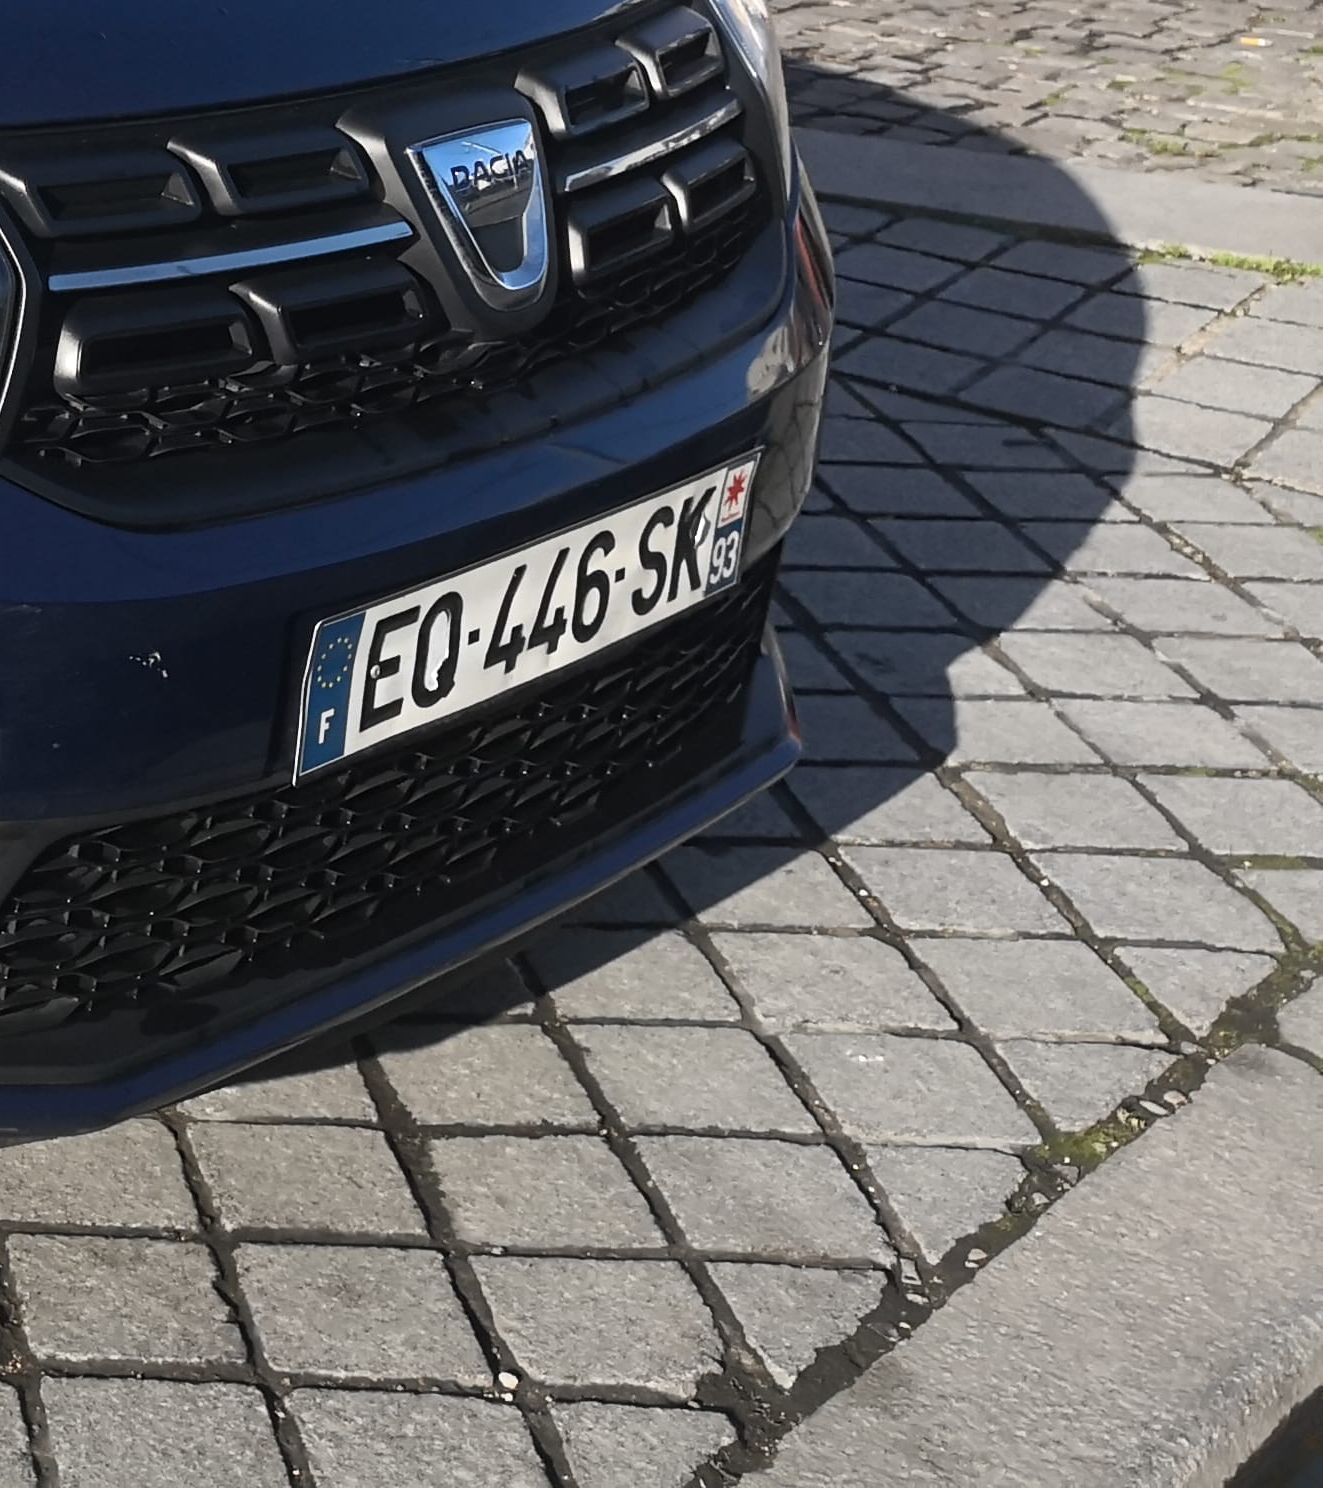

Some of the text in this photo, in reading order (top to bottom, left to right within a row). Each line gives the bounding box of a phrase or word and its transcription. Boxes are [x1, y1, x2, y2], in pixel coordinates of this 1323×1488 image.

[450, 149, 531, 189] DACIA
[709, 530, 740, 585] 93
[359, 486, 717, 733] EQ-446-SK
[317, 708, 335, 745] F
